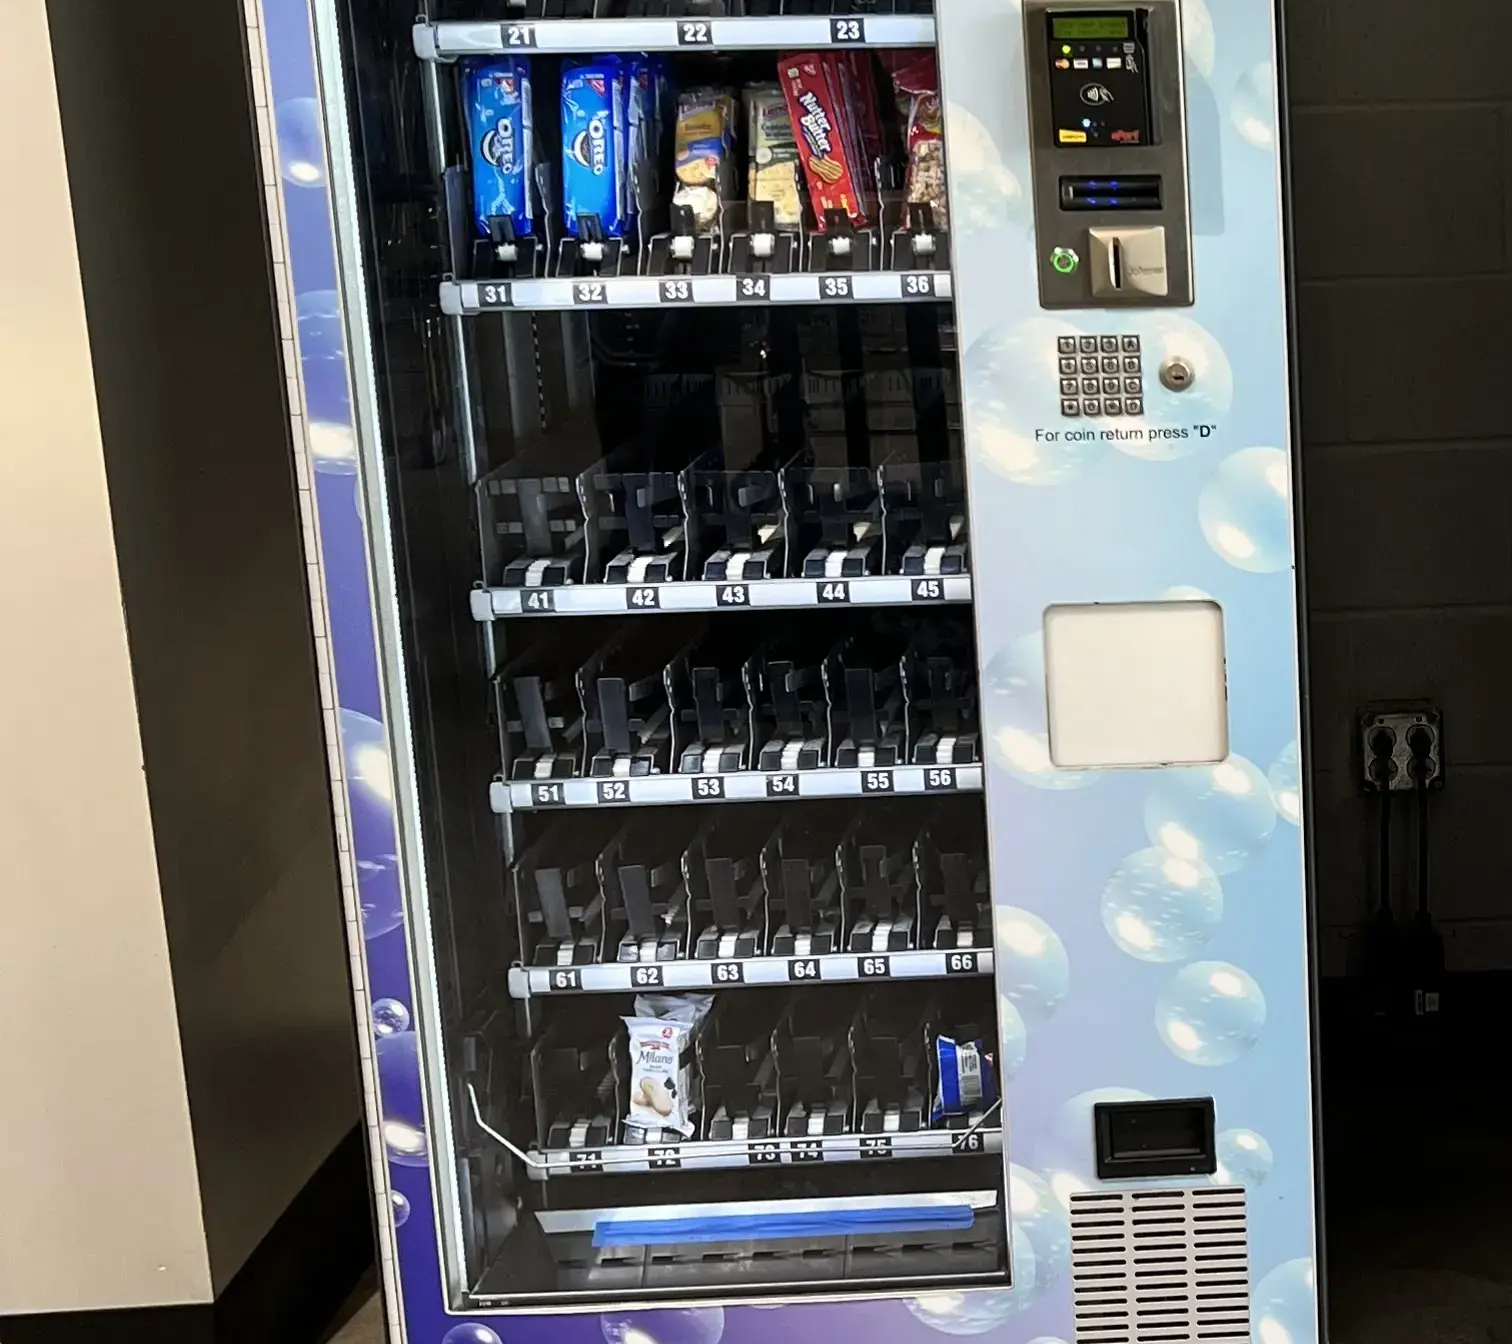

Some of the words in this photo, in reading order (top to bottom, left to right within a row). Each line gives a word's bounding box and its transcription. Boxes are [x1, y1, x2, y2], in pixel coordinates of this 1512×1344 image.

[508, 25, 531, 45] 21
[683, 22, 707, 44] 22
[837, 21, 859, 39] 23
[800, 92, 831, 132] Nutter
[800, 111, 831, 152] Butter
[498, 118, 513, 174] OREO
[588, 119, 604, 176] OREO
[580, 284, 603, 301] 32
[665, 282, 688, 299] 33
[743, 279, 765, 296] 34
[825, 278, 847, 295] 35
[907, 276, 929, 293] 36
[485, 286, 506, 302] 31
[1035, 429, 1060, 442] For
[1065, 428, 1095, 441] coin
[1100, 428, 1143, 441] return
[1148, 428, 1189, 442] press
[632, 589, 654, 605] 42
[723, 586, 744, 603] 43
[823, 583, 845, 599] 44
[917, 581, 939, 597] 45
[528, 592, 548, 608] 41
[768, 775, 794, 791] 54
[868, 773, 889, 789] 55
[930, 770, 951, 785] 56
[539, 785, 558, 801] 51
[603, 783, 625, 799] 52
[698, 779, 719, 795] 53
[795, 961, 815, 977] 64
[864, 959, 885, 974] 65
[952, 955, 972, 969] 66
[556, 971, 575, 987] 61
[637, 968, 658, 983] 62
[717, 964, 738, 980] 63
[636, 1051, 673, 1064] Milano
[866, 1139, 887, 1156] 75
[959, 1134, 978, 1151] 76
[654, 1149, 674, 1166] 72
[755, 1145, 776, 1162] 73
[798, 1143, 818, 1160] 74
[577, 1154, 597, 1169] 71
